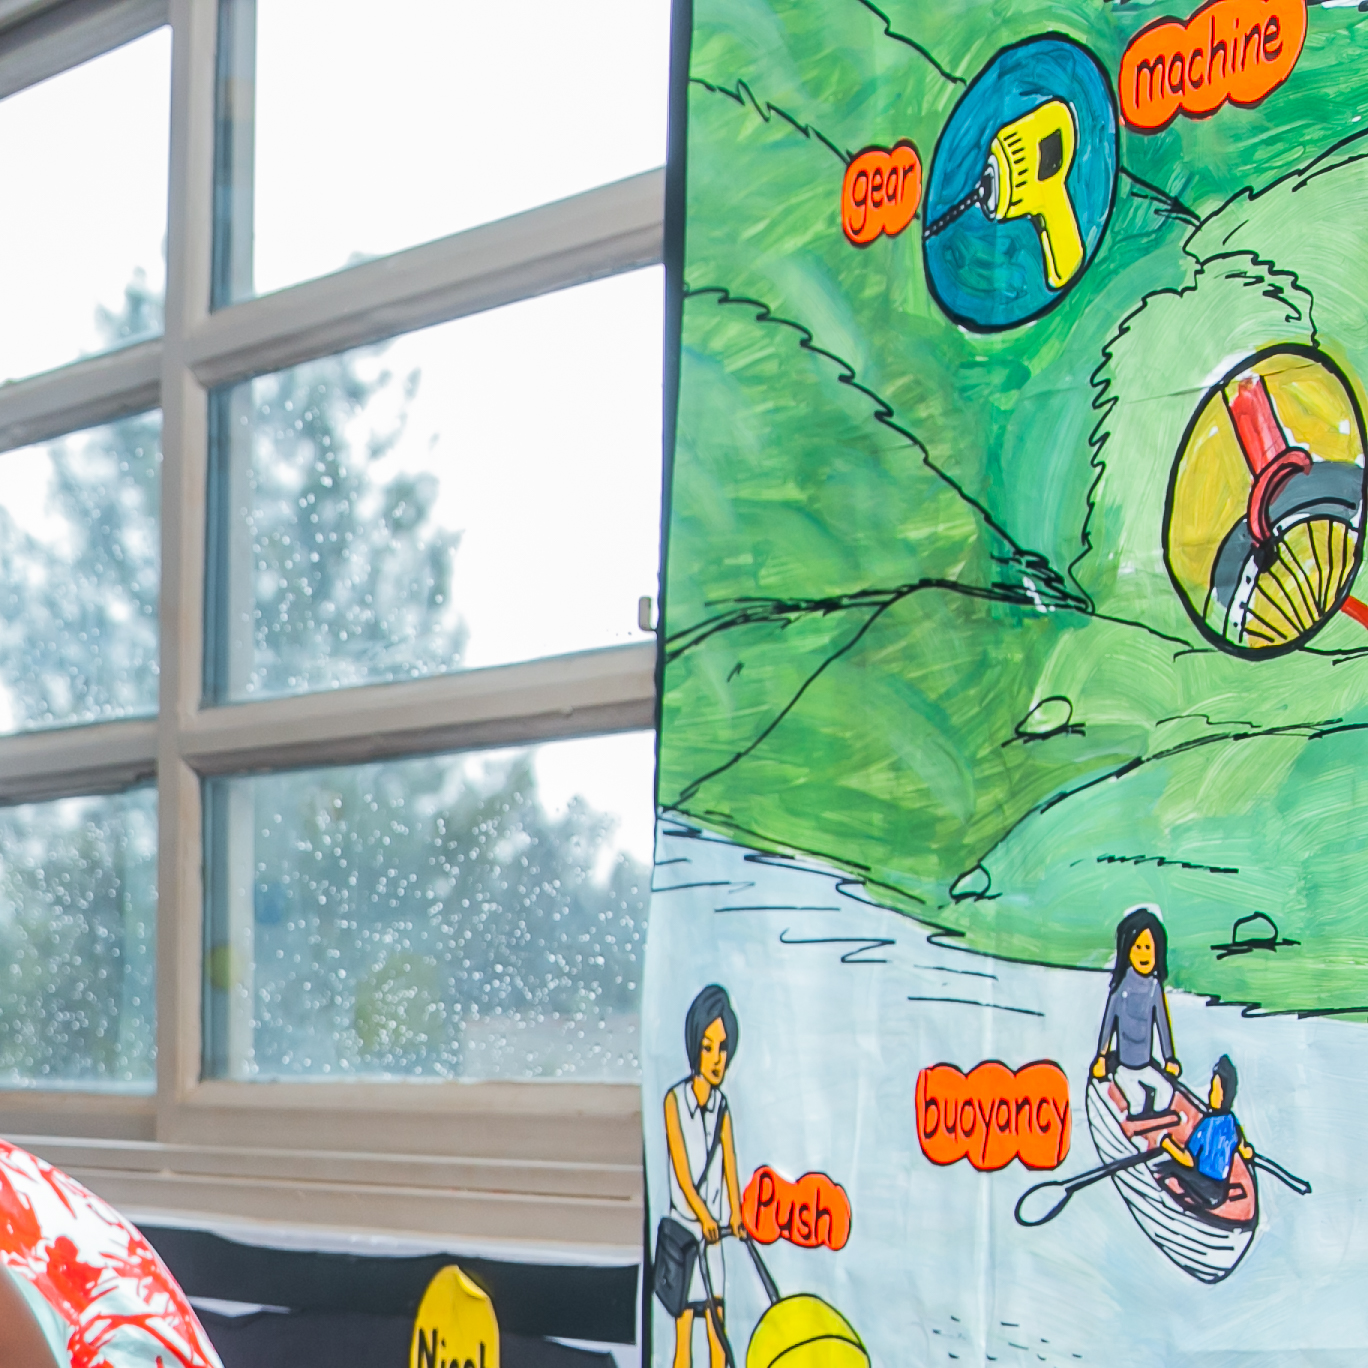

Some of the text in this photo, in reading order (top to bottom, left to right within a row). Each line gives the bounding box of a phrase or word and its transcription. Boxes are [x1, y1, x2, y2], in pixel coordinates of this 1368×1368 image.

[1134, 15, 1285, 109] machine
[850, 158, 915, 235] gear
[922, 1084, 1070, 1163] buoyancy
[755, 1180, 833, 1248] Push
